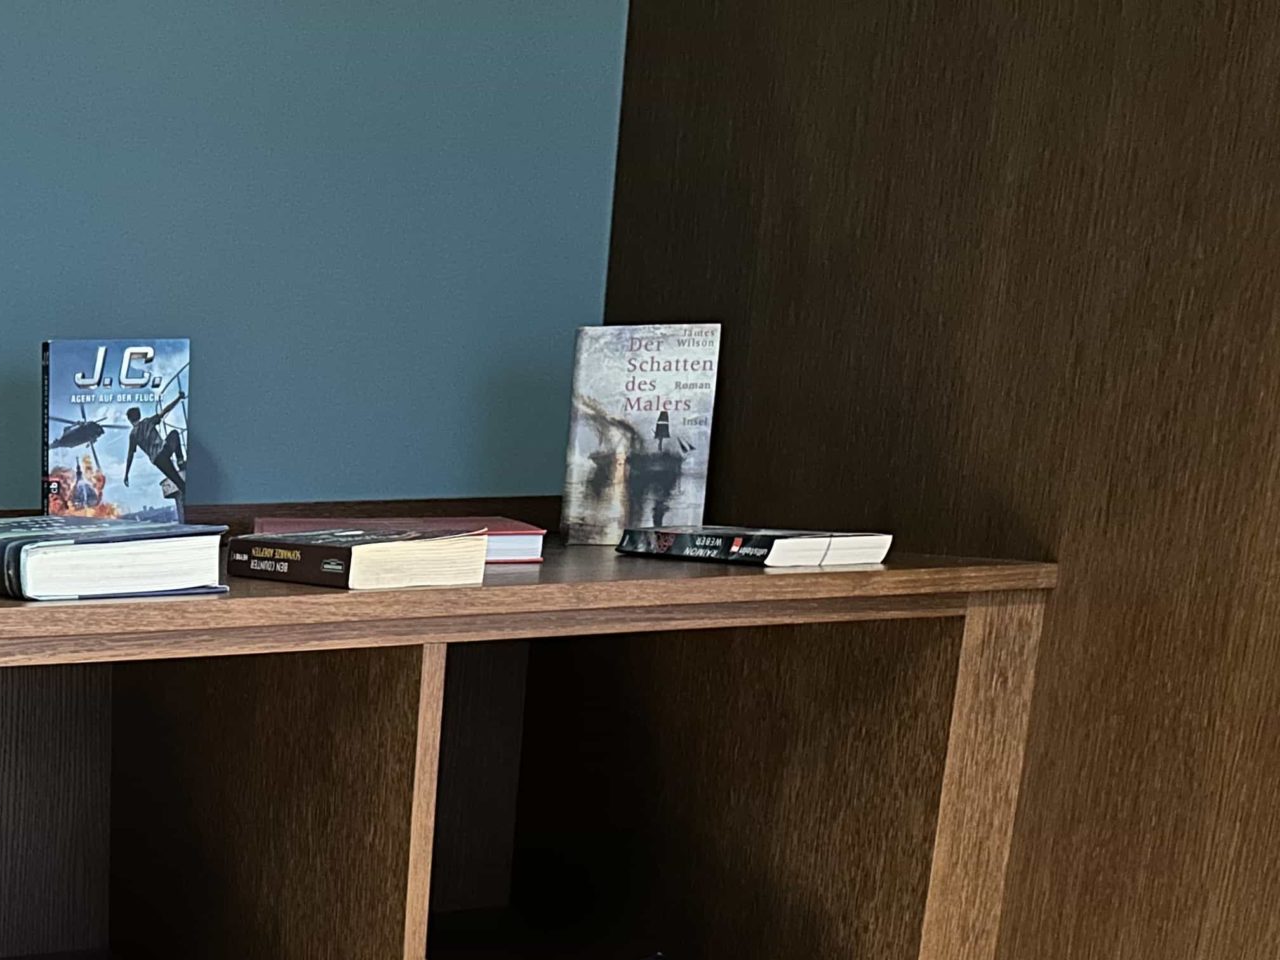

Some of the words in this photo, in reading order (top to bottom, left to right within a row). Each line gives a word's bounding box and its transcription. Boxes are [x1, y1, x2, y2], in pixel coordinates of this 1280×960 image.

[628, 337, 663, 353] Der
[677, 337, 715, 348] Wilson
[627, 357, 714, 373] Schatten
[625, 376, 657, 392] des
[674, 381, 711, 391] Roman
[71, 394, 96, 403] AGENT
[100, 394, 113, 403] AUF
[117, 393, 132, 402] DER
[624, 396, 692, 412] Malers
[682, 416, 709, 427] Insel
[695, 536, 722, 547] WEBER
[250, 559, 275, 572] COUNTER
[276, 562, 289, 573] BEN
